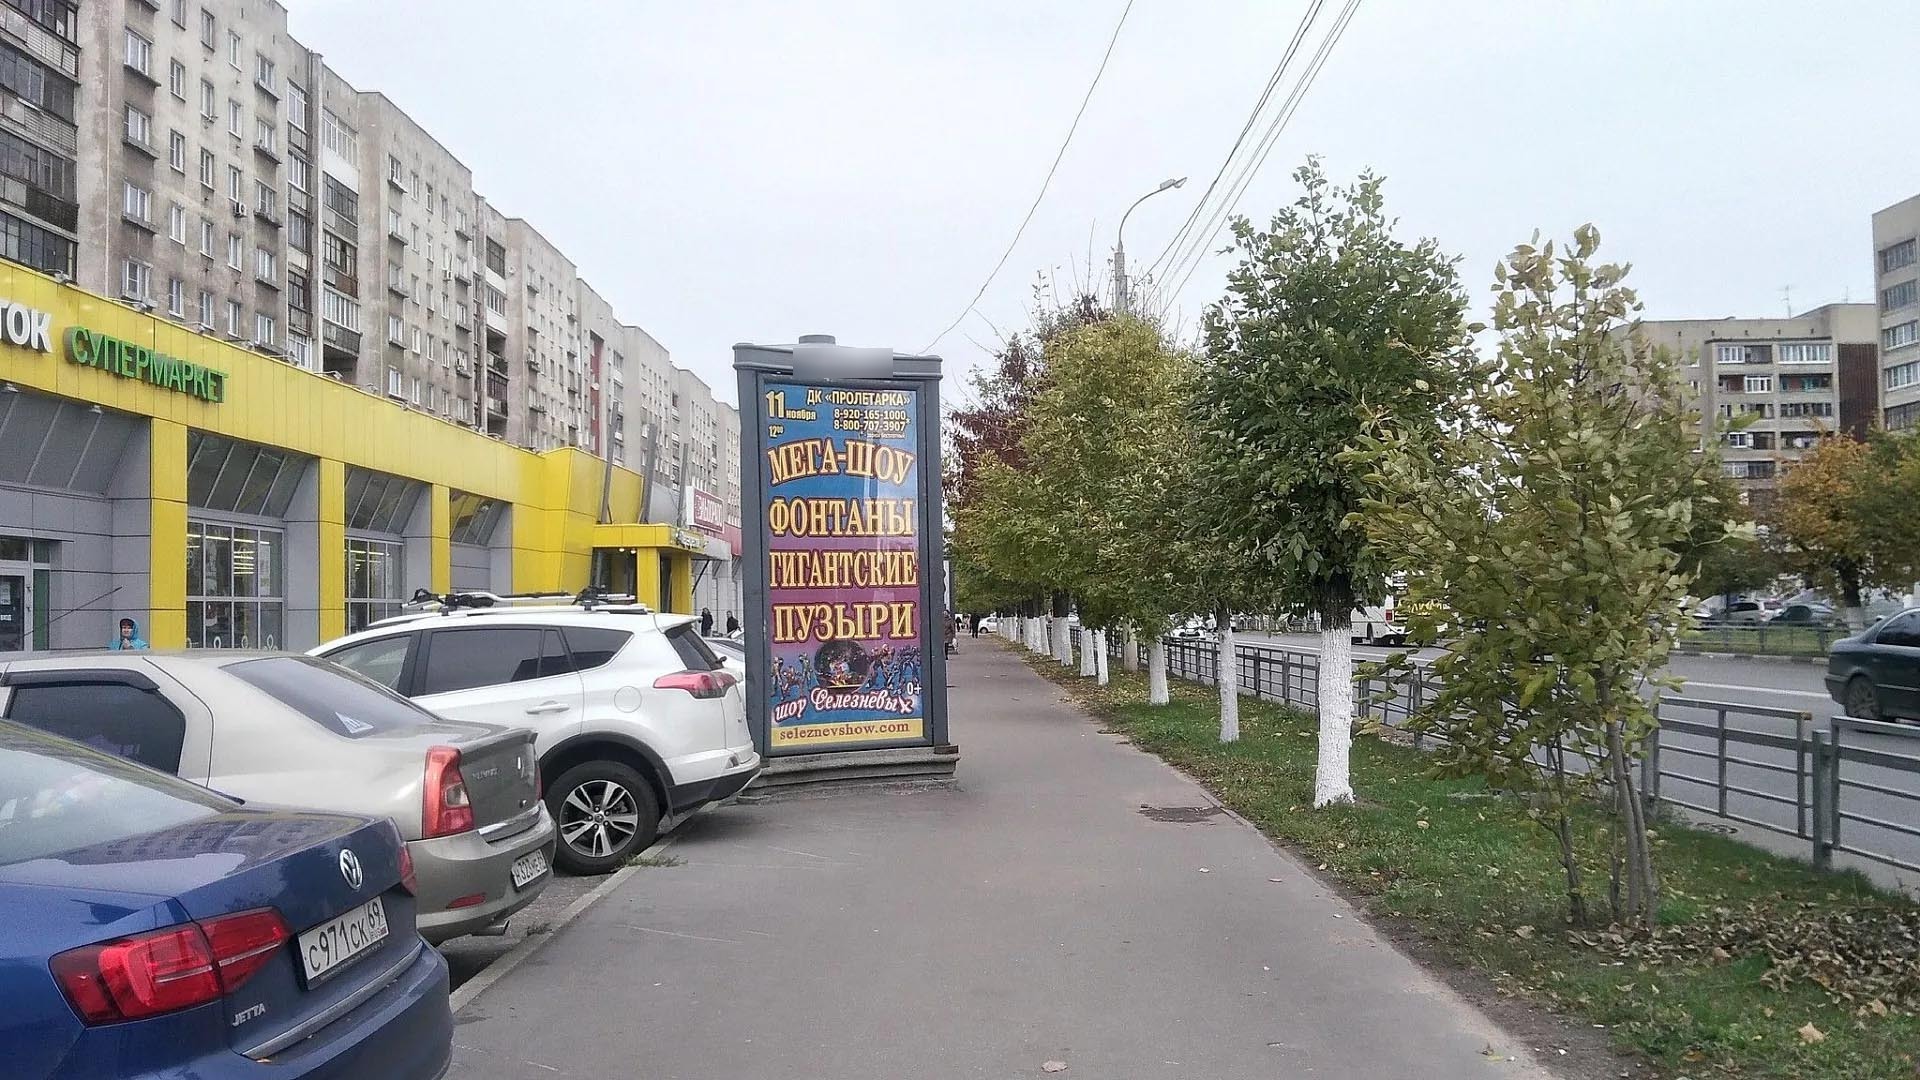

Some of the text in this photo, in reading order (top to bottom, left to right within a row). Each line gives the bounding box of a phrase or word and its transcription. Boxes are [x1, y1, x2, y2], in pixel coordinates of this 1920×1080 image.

[67, 326, 229, 403] СУПЕРМАРКЕТ
[766, 390, 816, 420] 11 ноября
[807, 390, 911, 406] ДК «ПРОЛЕТАРКА»
[833, 420, 906, 431] 8-800-707-3907
[834, 409, 906, 420] 8-920-165-1000
[766, 439, 915, 484] МЕГА-ШОУ
[769, 499, 914, 536] ФОНТАНЫ
[769, 551, 918, 587] ГИГАНТСКИЕ
[773, 603, 916, 642] ПУЗЫРИ
[906, 682, 922, 696] 0+
[780, 722, 910, 740] seleznevshow.com
[232, 1002, 266, 1027] JETTA
